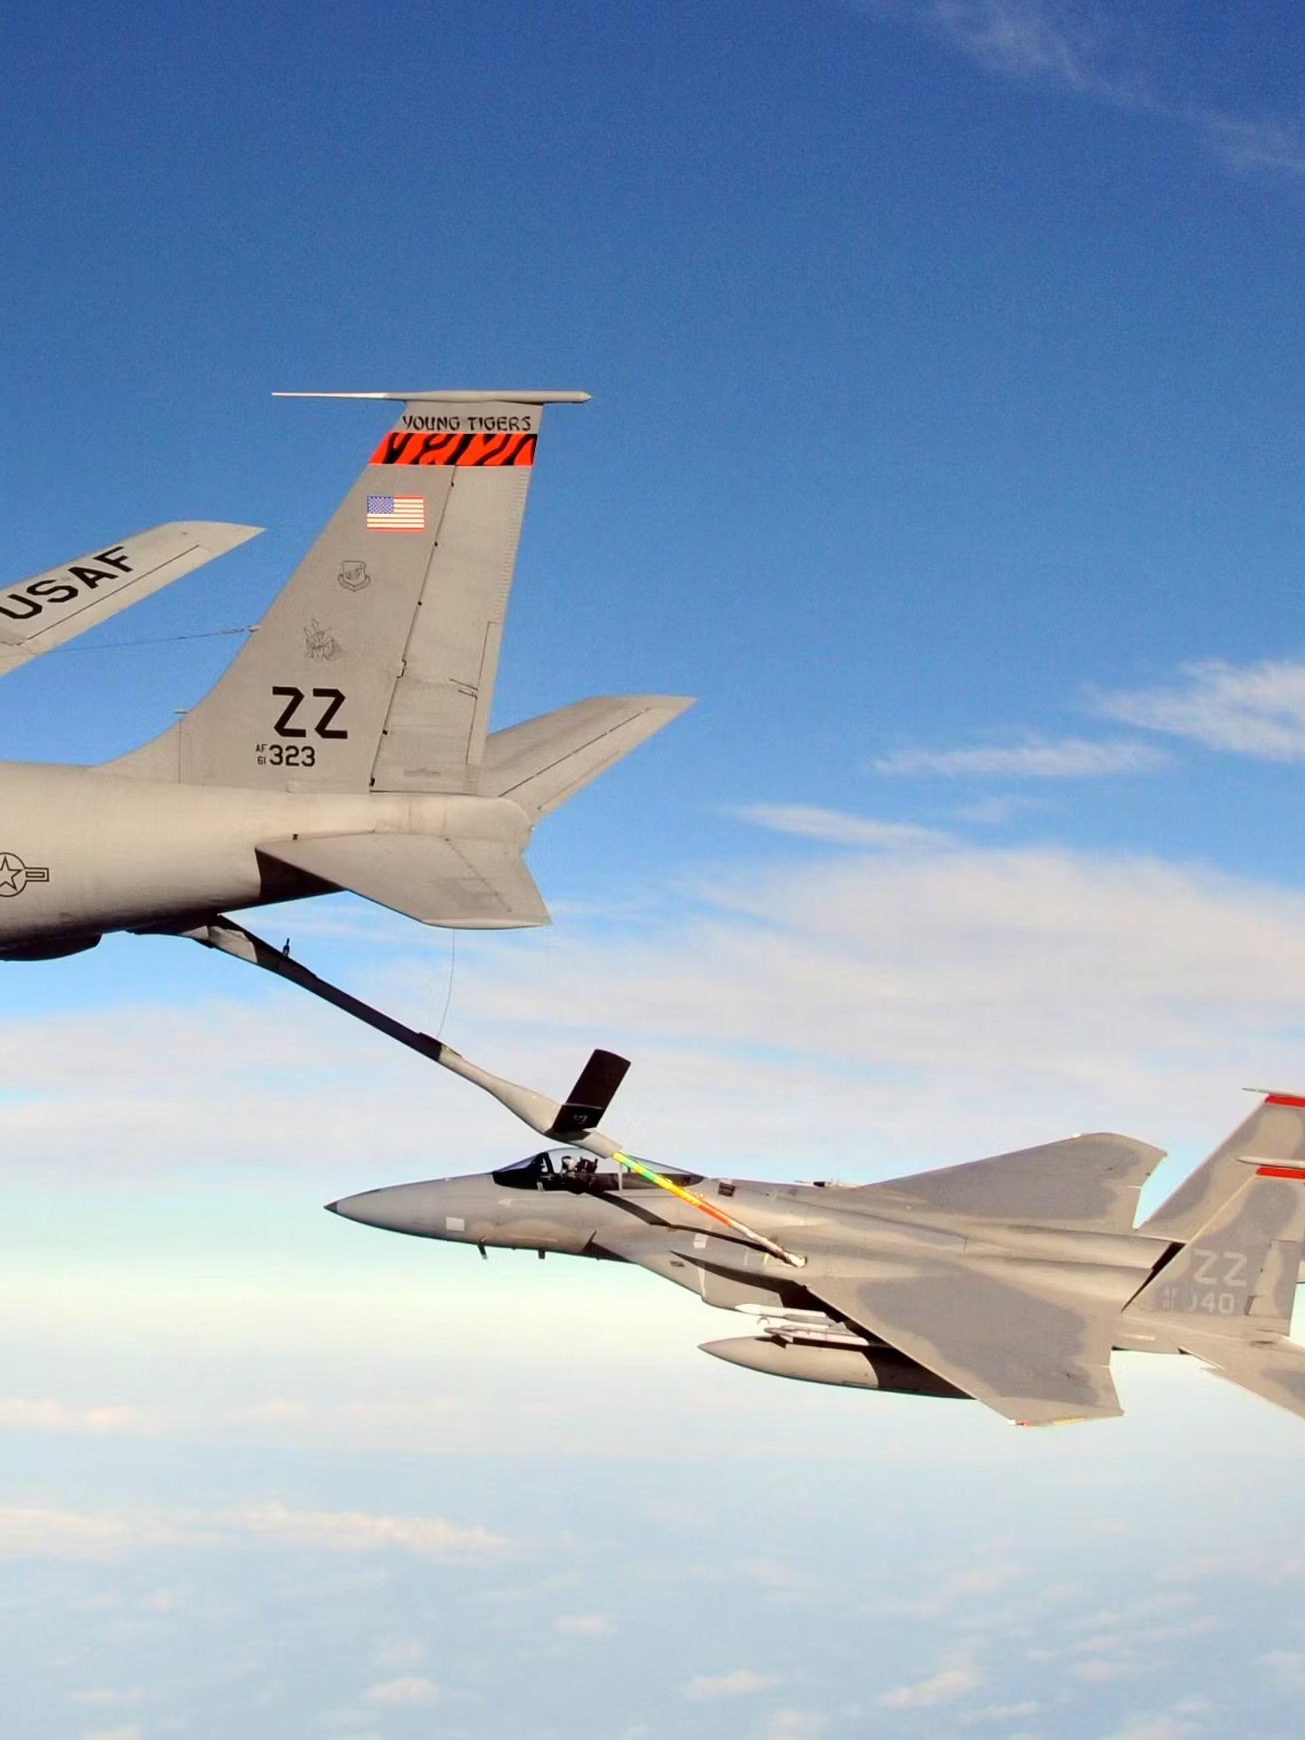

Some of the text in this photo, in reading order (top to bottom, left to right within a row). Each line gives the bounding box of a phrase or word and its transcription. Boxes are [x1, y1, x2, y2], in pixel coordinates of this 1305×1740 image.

[402, 415, 531, 431] YOUNG TIGERS
[272, 686, 348, 739] ZZ
[256, 744, 267, 752] AF
[269, 745, 315, 767] 323
[257, 757, 266, 765] 61
[1193, 1248, 1248, 1287] ZZ
